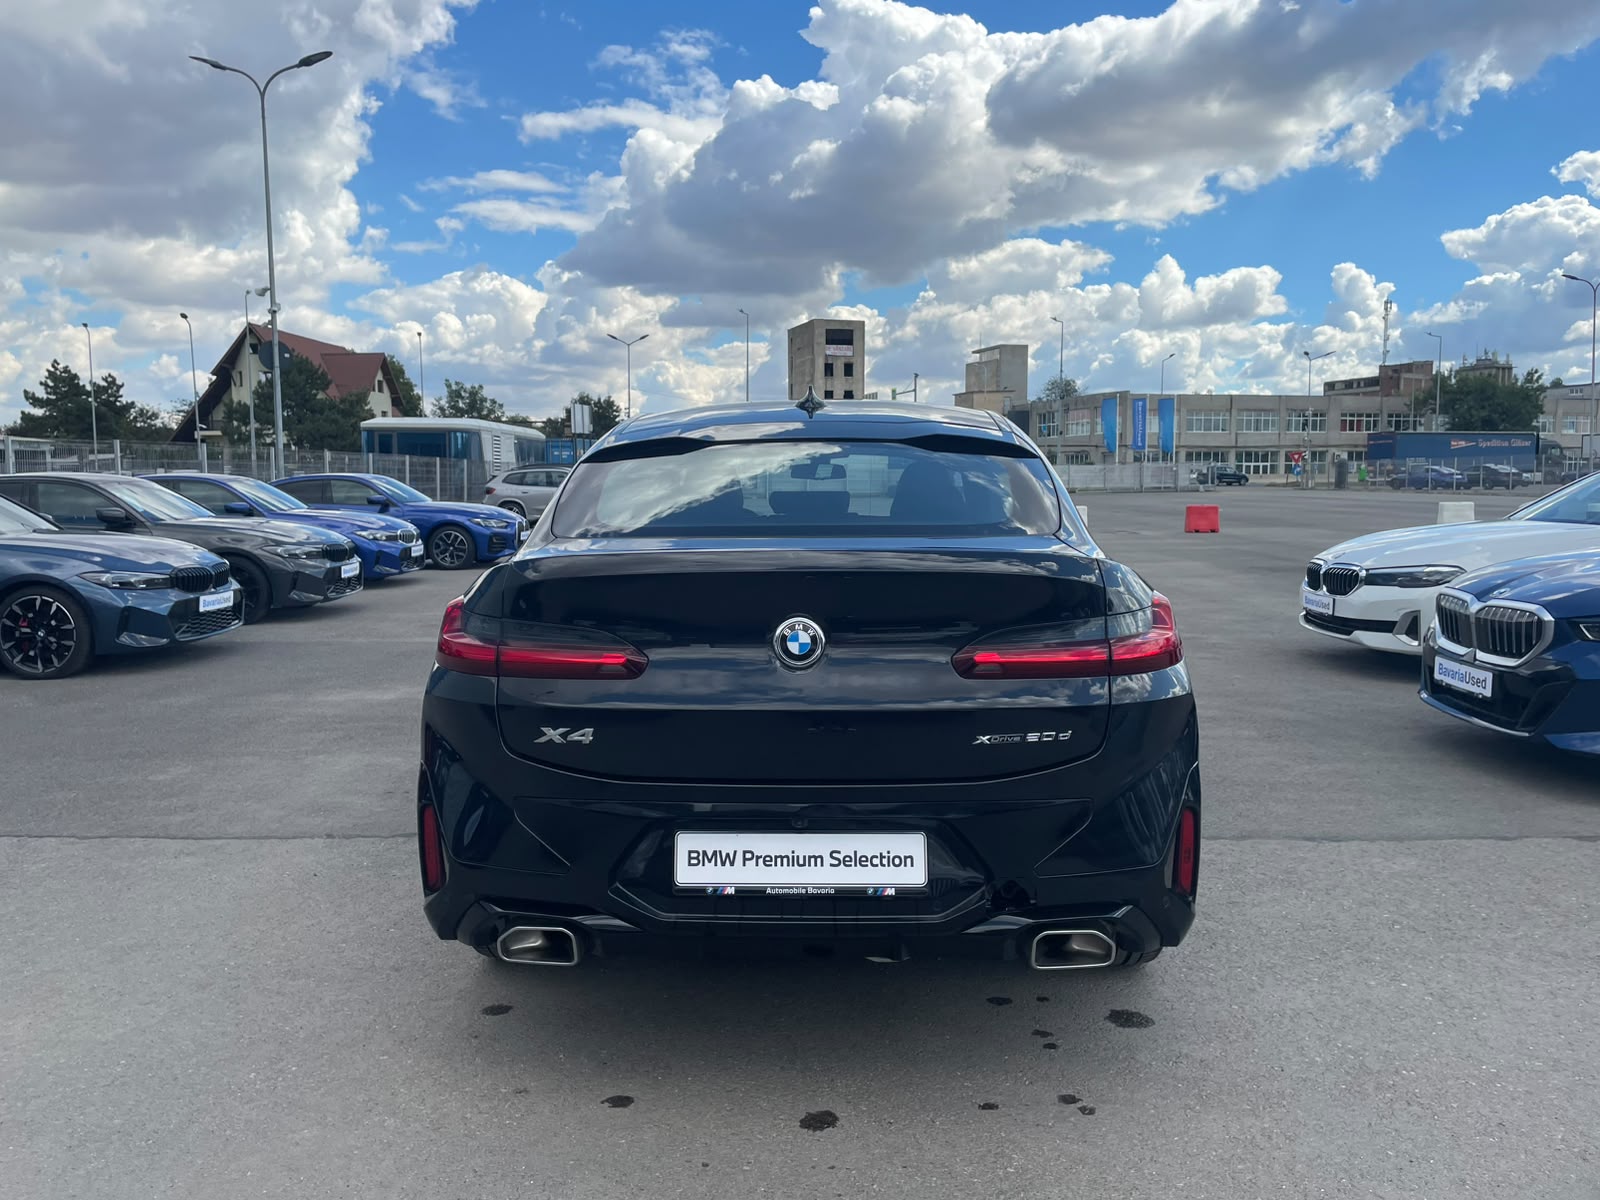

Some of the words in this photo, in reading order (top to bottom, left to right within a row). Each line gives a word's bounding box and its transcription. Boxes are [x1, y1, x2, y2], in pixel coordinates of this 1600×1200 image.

[783, 623, 816, 636] BMW
[1438, 662, 1487, 690] BavariaUsed
[533, 727, 595, 744] X4
[687, 849, 738, 867] BMW
[742, 849, 824, 868] Premium
[829, 849, 915, 868] Selection
[766, 887, 806, 895] Automobile
[807, 887, 835, 895] Bavaria
